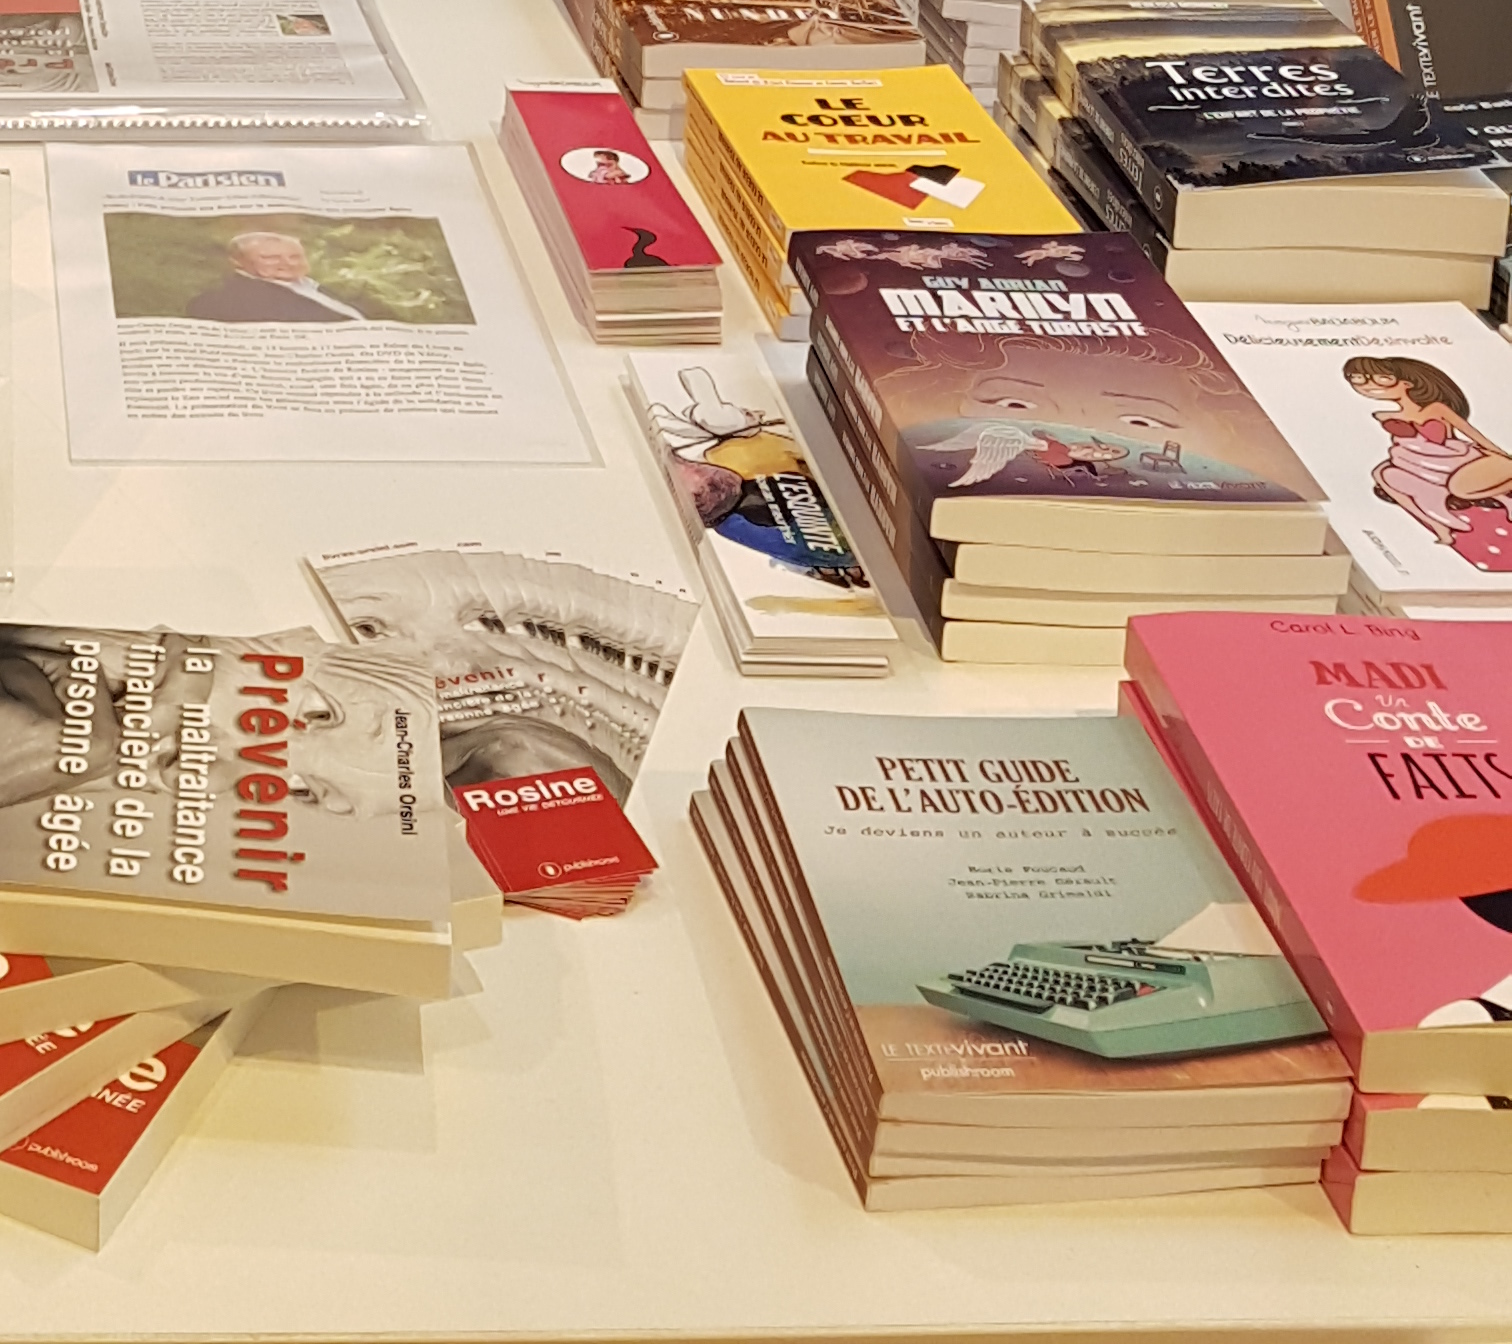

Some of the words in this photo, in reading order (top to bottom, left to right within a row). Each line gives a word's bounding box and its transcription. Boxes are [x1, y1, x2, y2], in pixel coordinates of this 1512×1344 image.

[1145, 61, 1339, 87] Terres
[780, 114, 930, 127] COEUR
[814, 98, 871, 111] LE
[814, 132, 981, 145] TRAVAIL
[921, 275, 969, 290] GUY
[878, 288, 1138, 321] MARILYN
[185, 646, 221, 673] la
[1309, 661, 1449, 691] MADI
[57, 638, 101, 775] personne
[117, 642, 167, 790] financière
[1324, 697, 1488, 732] Conte
[394, 707, 415, 790] Jean-Charles
[235, 653, 307, 893] Prévenir
[875, 756, 970, 784] PETIT
[978, 759, 1081, 784] GUIDE
[173, 702, 219, 886] maltraitance
[462, 775, 598, 812] Rosine
[835, 785, 884, 812] DE
[110, 796, 155, 839] de
[399, 793, 419, 837] Orsini
[41, 792, 97, 873] âgée
[108, 847, 151, 878] la
[919, 1063, 1016, 1081] publishroom
